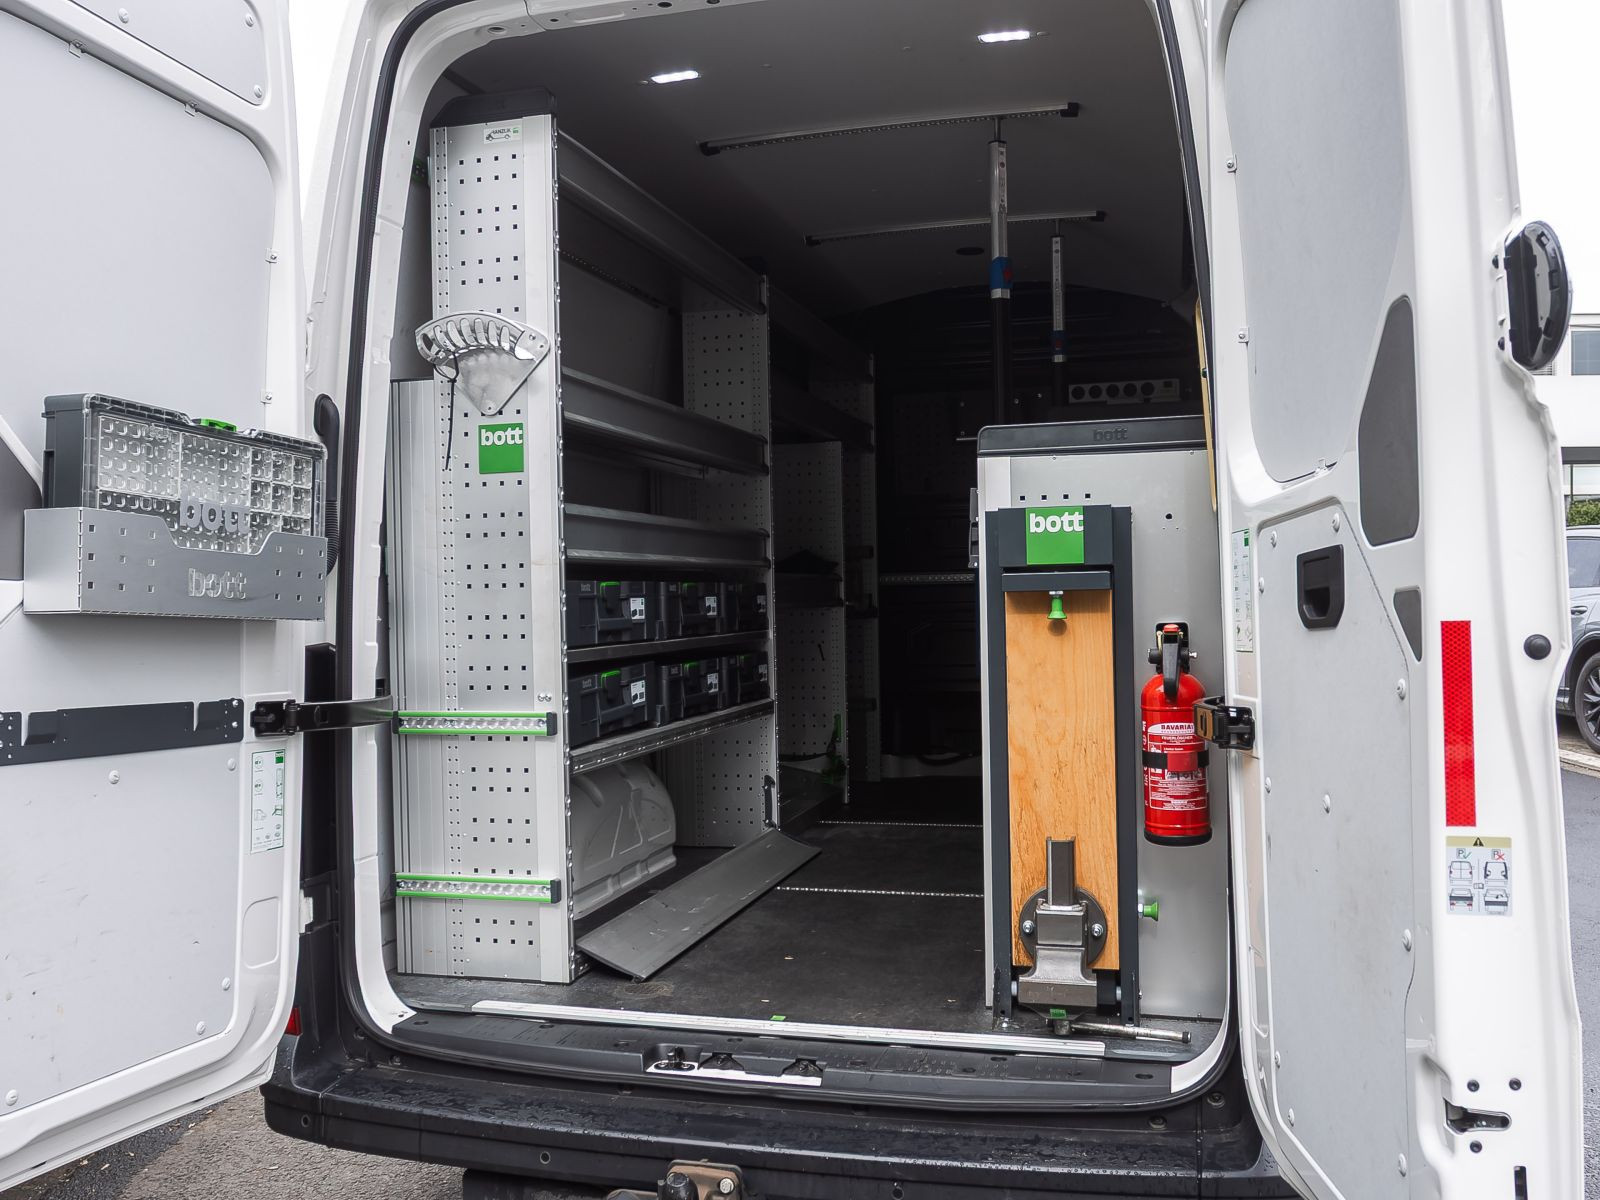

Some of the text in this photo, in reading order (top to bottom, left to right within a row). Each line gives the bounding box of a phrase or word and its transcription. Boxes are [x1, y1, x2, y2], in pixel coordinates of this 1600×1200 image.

[481, 427, 523, 446] bott
[1093, 427, 1128, 441] bott
[180, 484, 250, 534] bott
[1029, 511, 1084, 533] bott
[188, 567, 247, 599] bott
